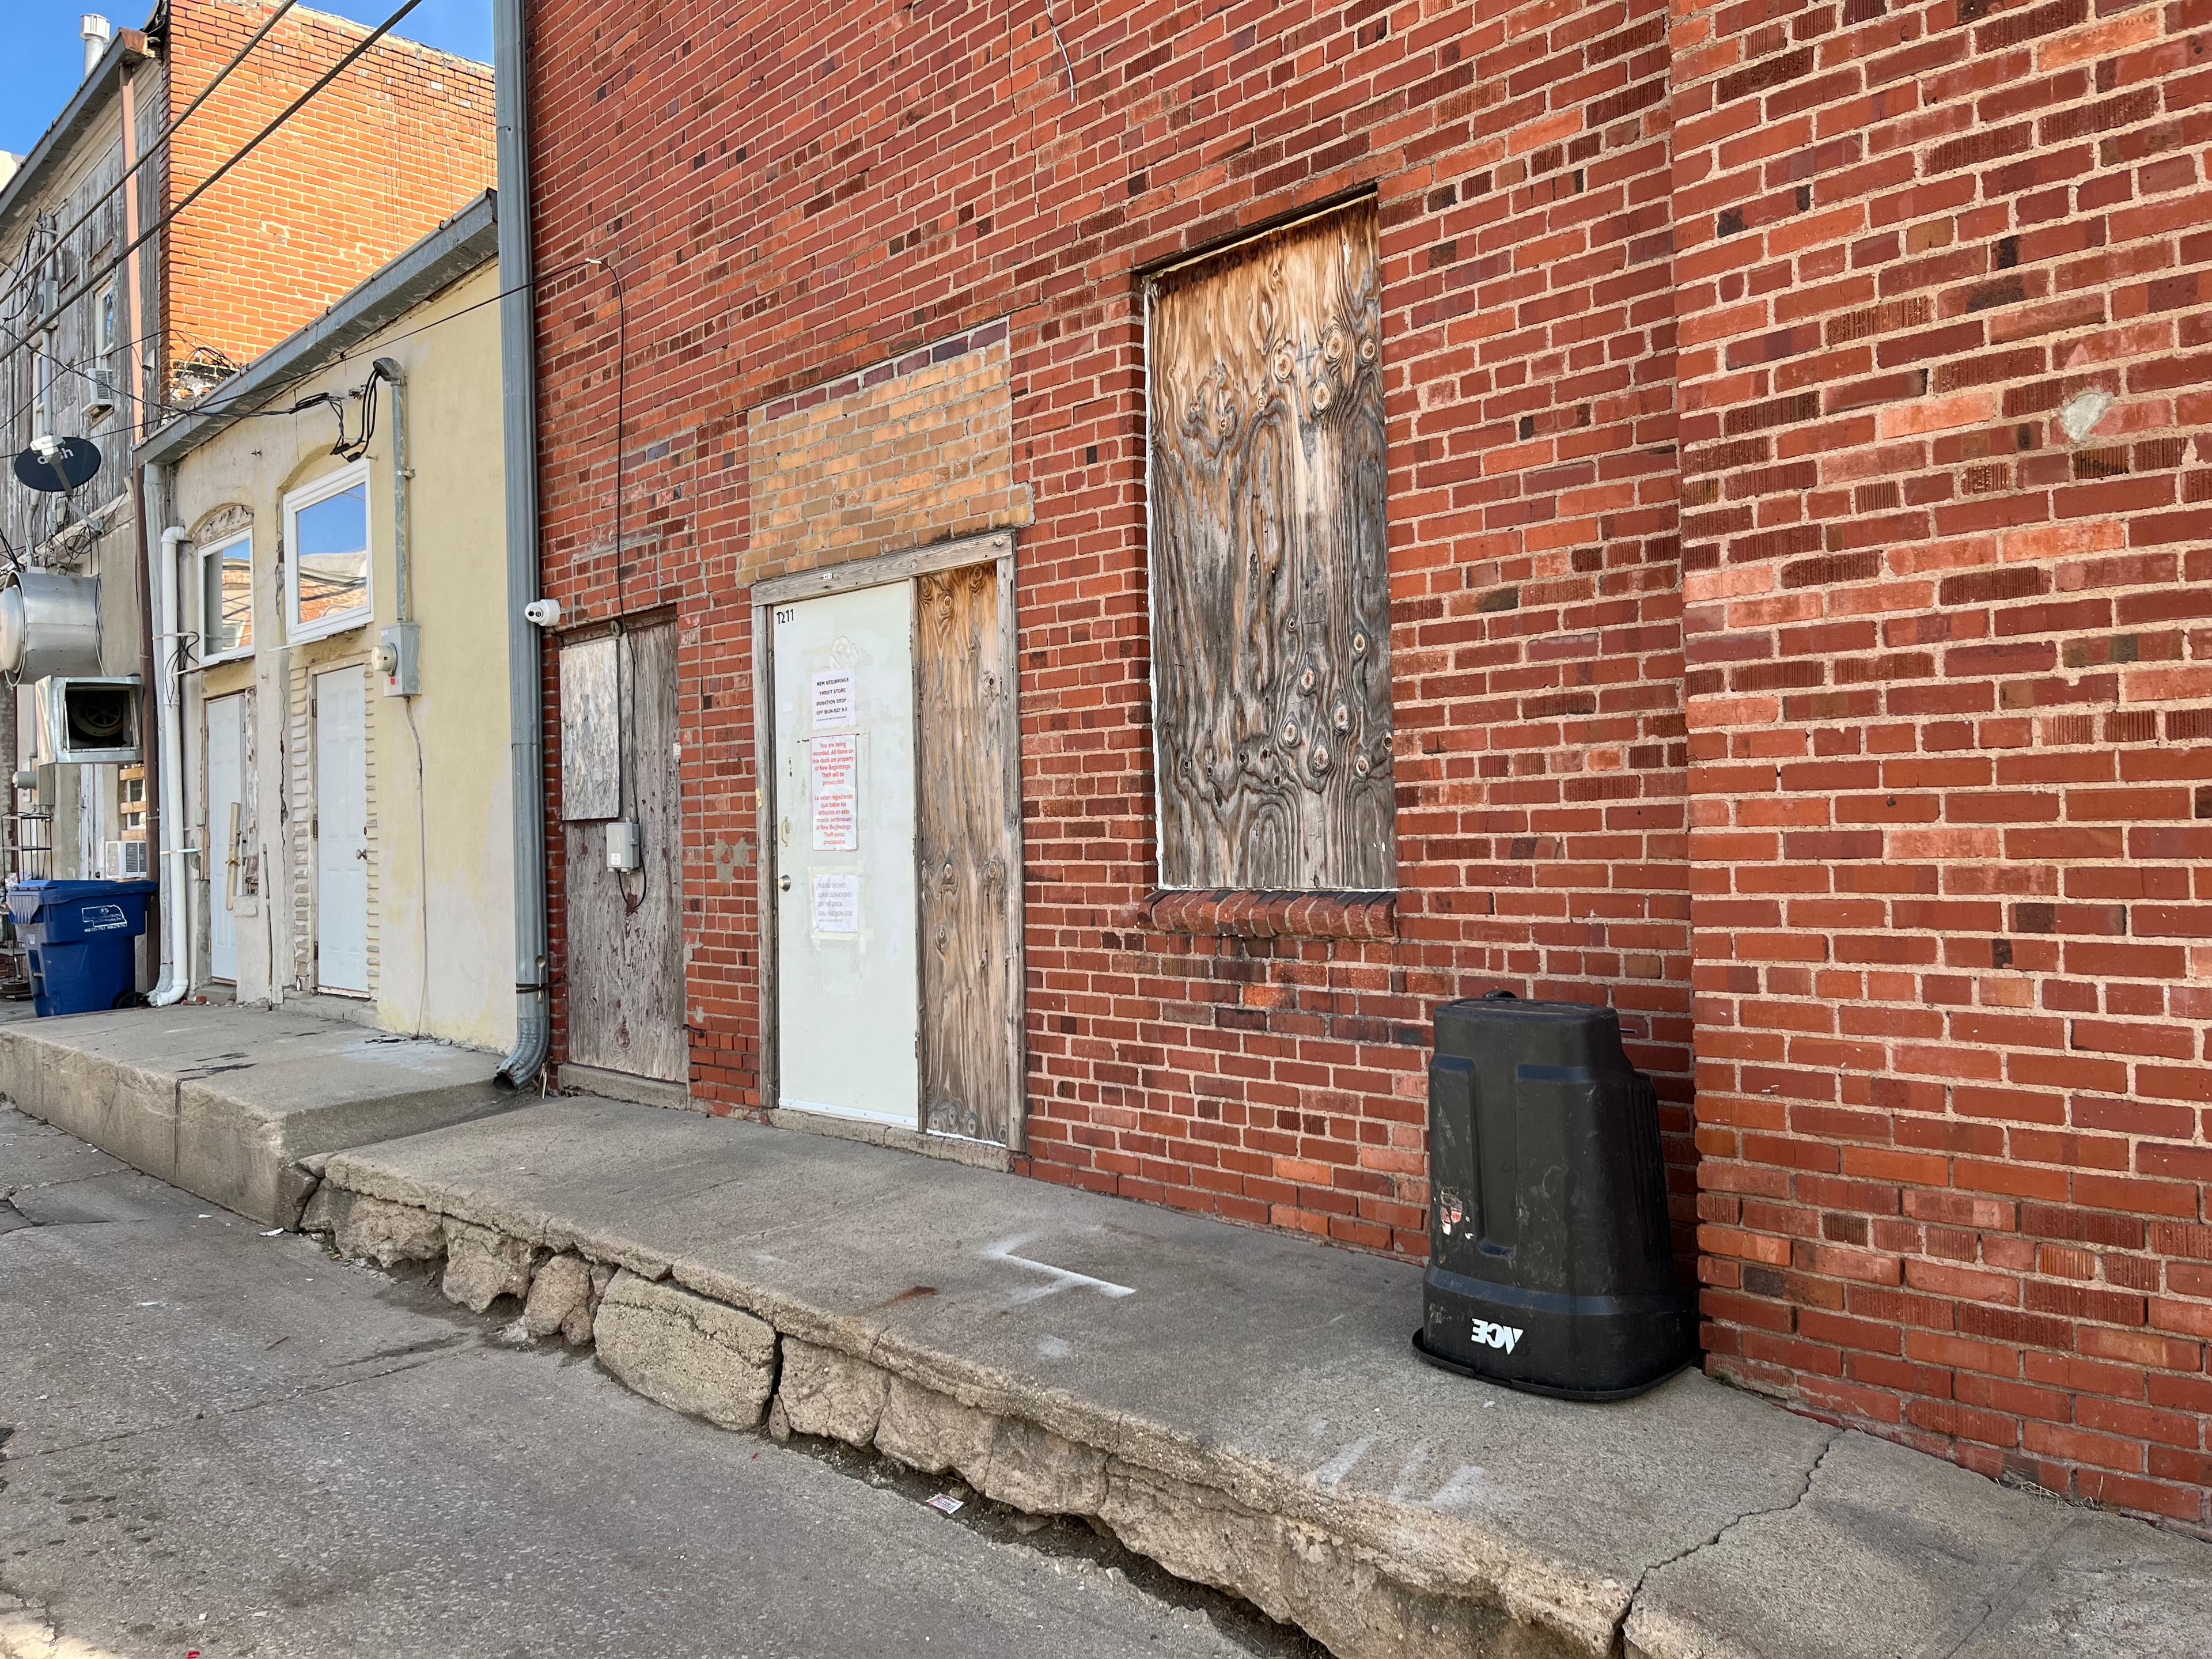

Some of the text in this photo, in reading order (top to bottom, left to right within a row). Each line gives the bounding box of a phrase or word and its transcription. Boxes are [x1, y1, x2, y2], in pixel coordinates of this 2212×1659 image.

[37, 448, 74, 465] dh
[777, 608, 794, 624] 1211
[1471, 1318, 1524, 1355] ACE
